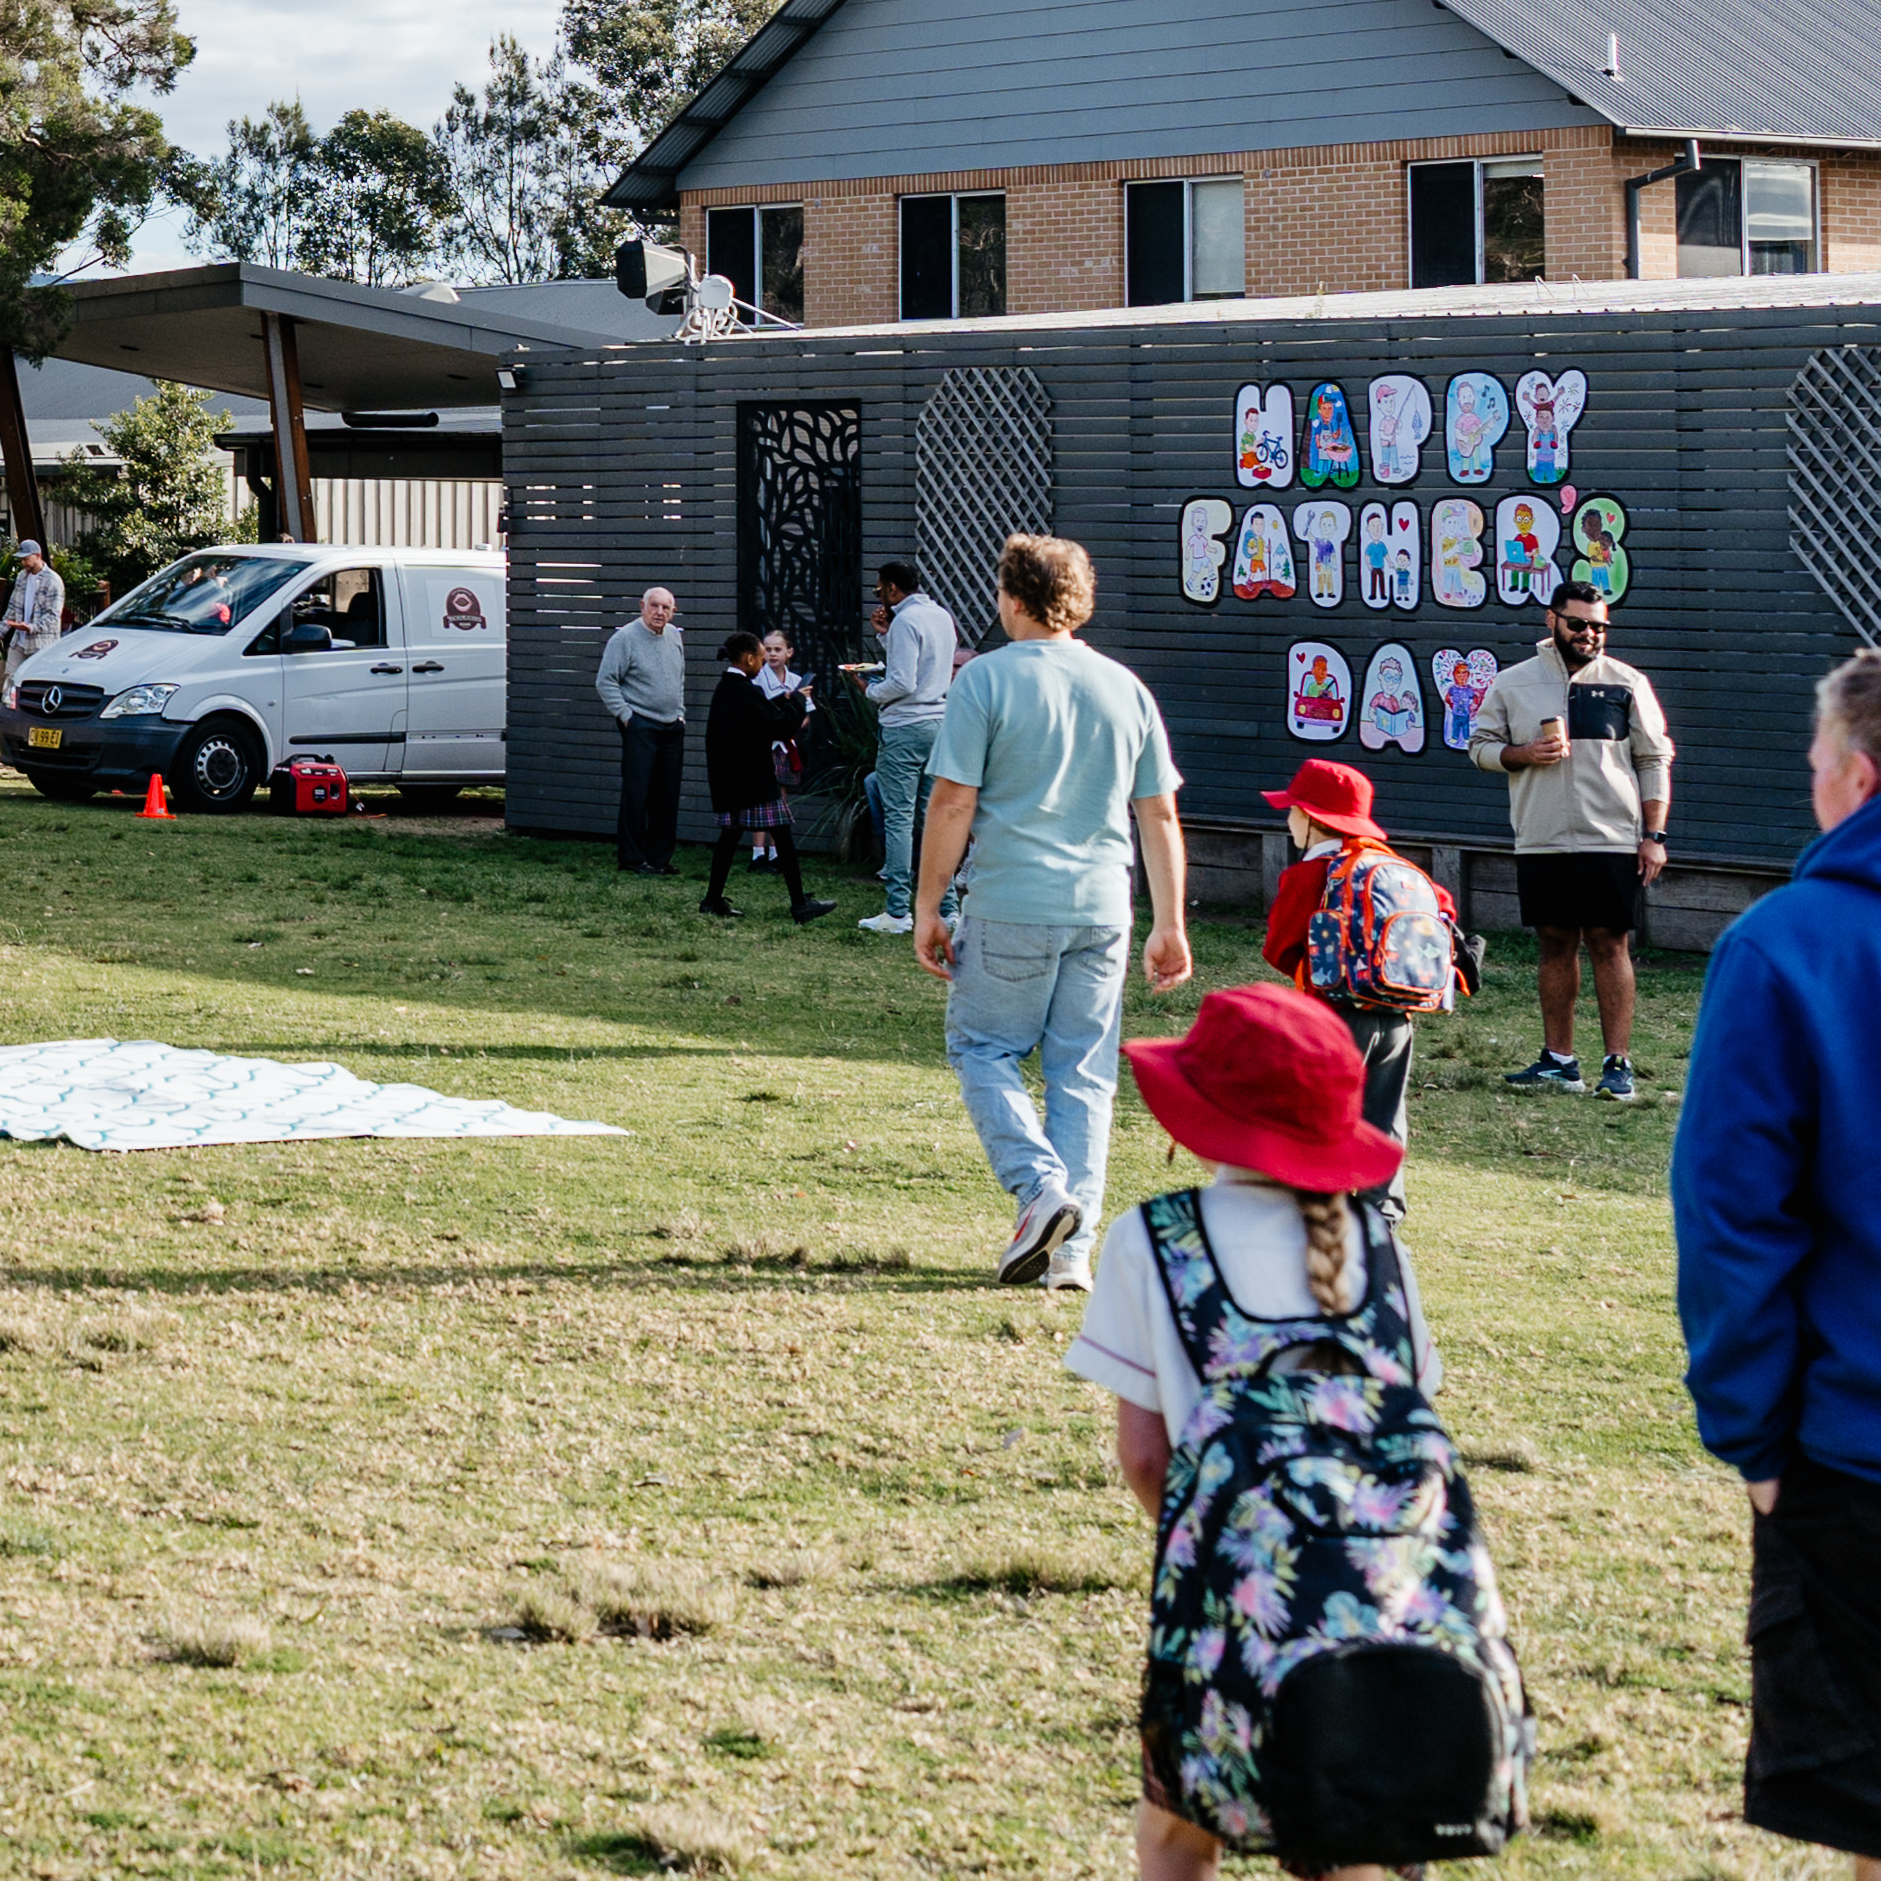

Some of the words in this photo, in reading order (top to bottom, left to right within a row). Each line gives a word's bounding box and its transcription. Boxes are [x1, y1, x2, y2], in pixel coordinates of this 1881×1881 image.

[1234, 367, 1588, 491] HAPPY
[1180, 485, 1631, 612] FATHER'S
[1286, 639, 1500, 756] DAY
